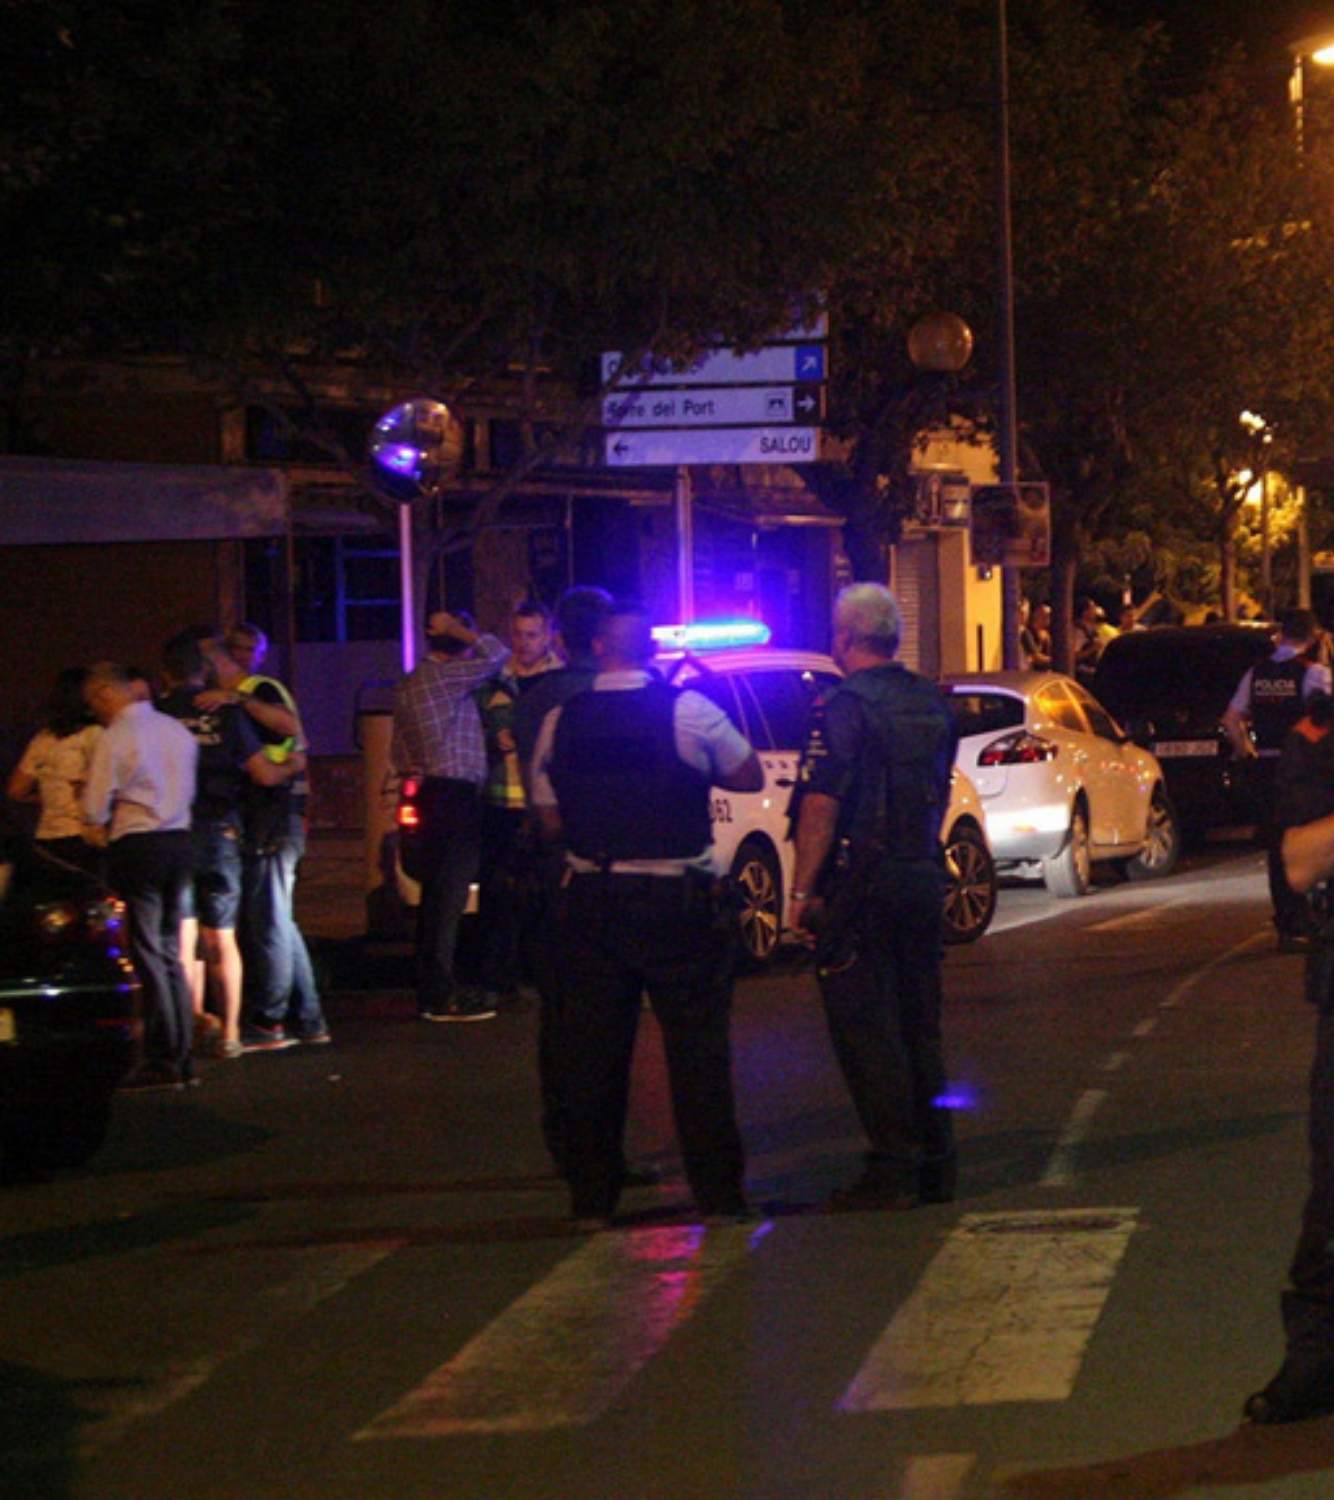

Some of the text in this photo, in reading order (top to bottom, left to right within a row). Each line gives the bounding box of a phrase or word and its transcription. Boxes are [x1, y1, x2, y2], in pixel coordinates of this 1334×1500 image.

[653, 400, 676, 416] del
[683, 398, 714, 416] Port
[761, 436, 810, 454] SALOU
[1255, 679, 1297, 689] POLICIA
